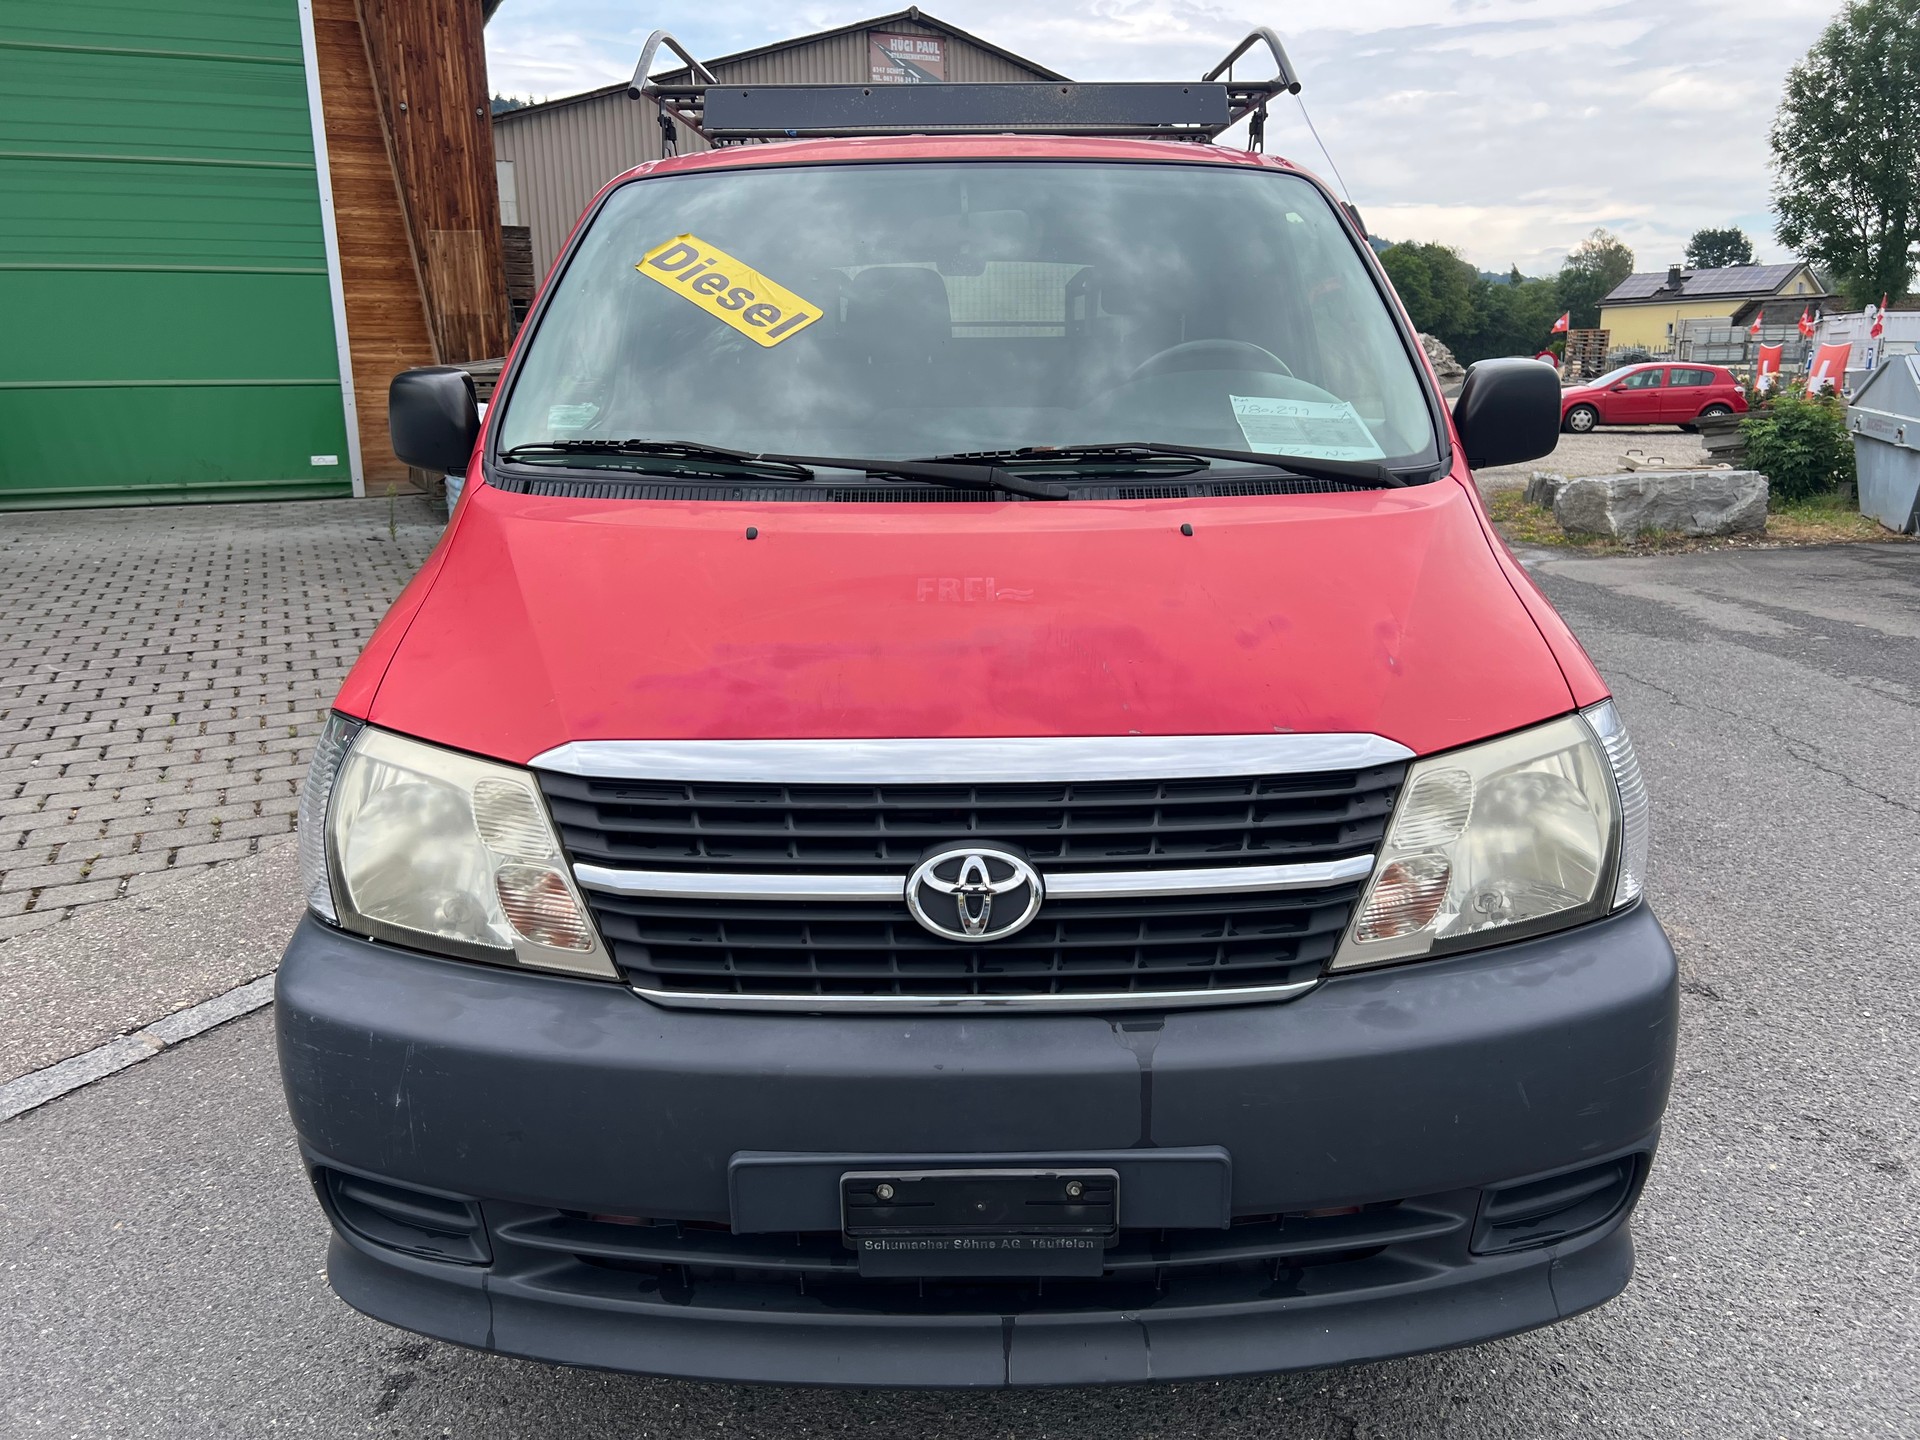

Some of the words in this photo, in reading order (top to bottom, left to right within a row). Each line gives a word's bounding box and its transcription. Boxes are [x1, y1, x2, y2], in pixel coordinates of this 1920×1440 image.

[916, 40, 940, 54] PAUL
[647, 242, 810, 339] Diesel
[864, 1240, 949, 1250] Schumacher
[953, 1239, 996, 1249] Söhne
[1001, 1239, 1021, 1249] AG
